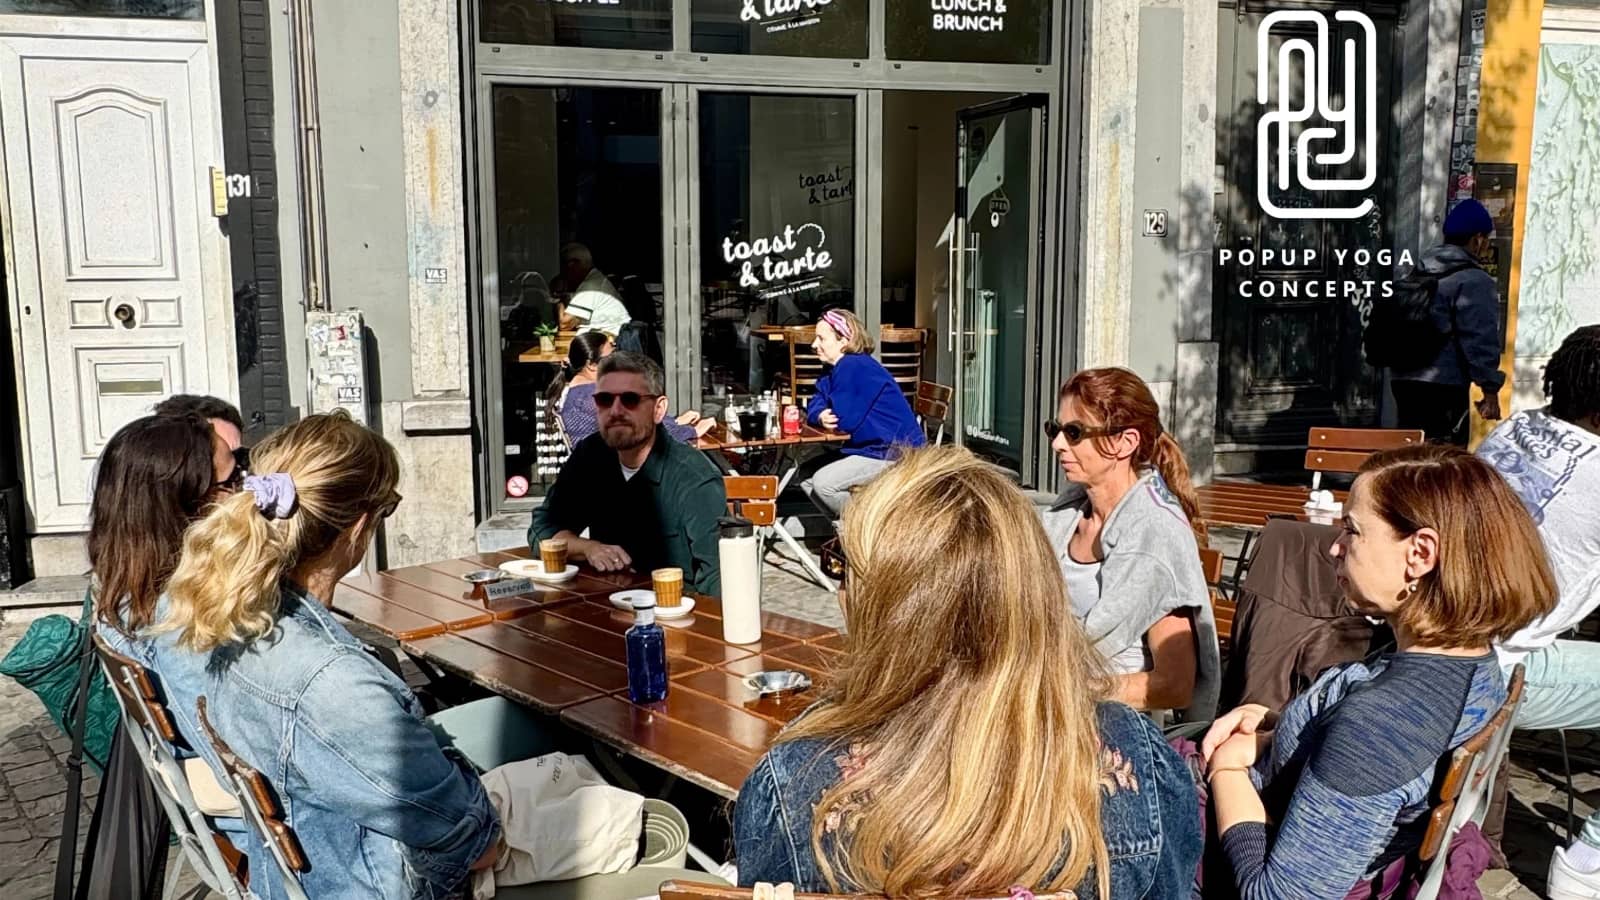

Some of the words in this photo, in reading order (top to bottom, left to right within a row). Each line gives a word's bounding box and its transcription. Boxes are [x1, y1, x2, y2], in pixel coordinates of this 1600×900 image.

[740, 0, 761, 21] &
[931, 0, 991, 12] LUNCH
[995, 0, 1007, 13] &
[933, 14, 1003, 31] BRUNCH
[226, 174, 251, 198] 131
[799, 165, 842, 189] toast
[809, 188, 821, 204] &
[823, 179, 853, 200] tart
[1144, 212, 1165, 234] 129
[722, 224, 797, 263] toast
[426, 269, 446, 279] VAS
[739, 261, 759, 287] &
[763, 246, 833, 281] tarte
[339, 387, 361, 398] VAS
